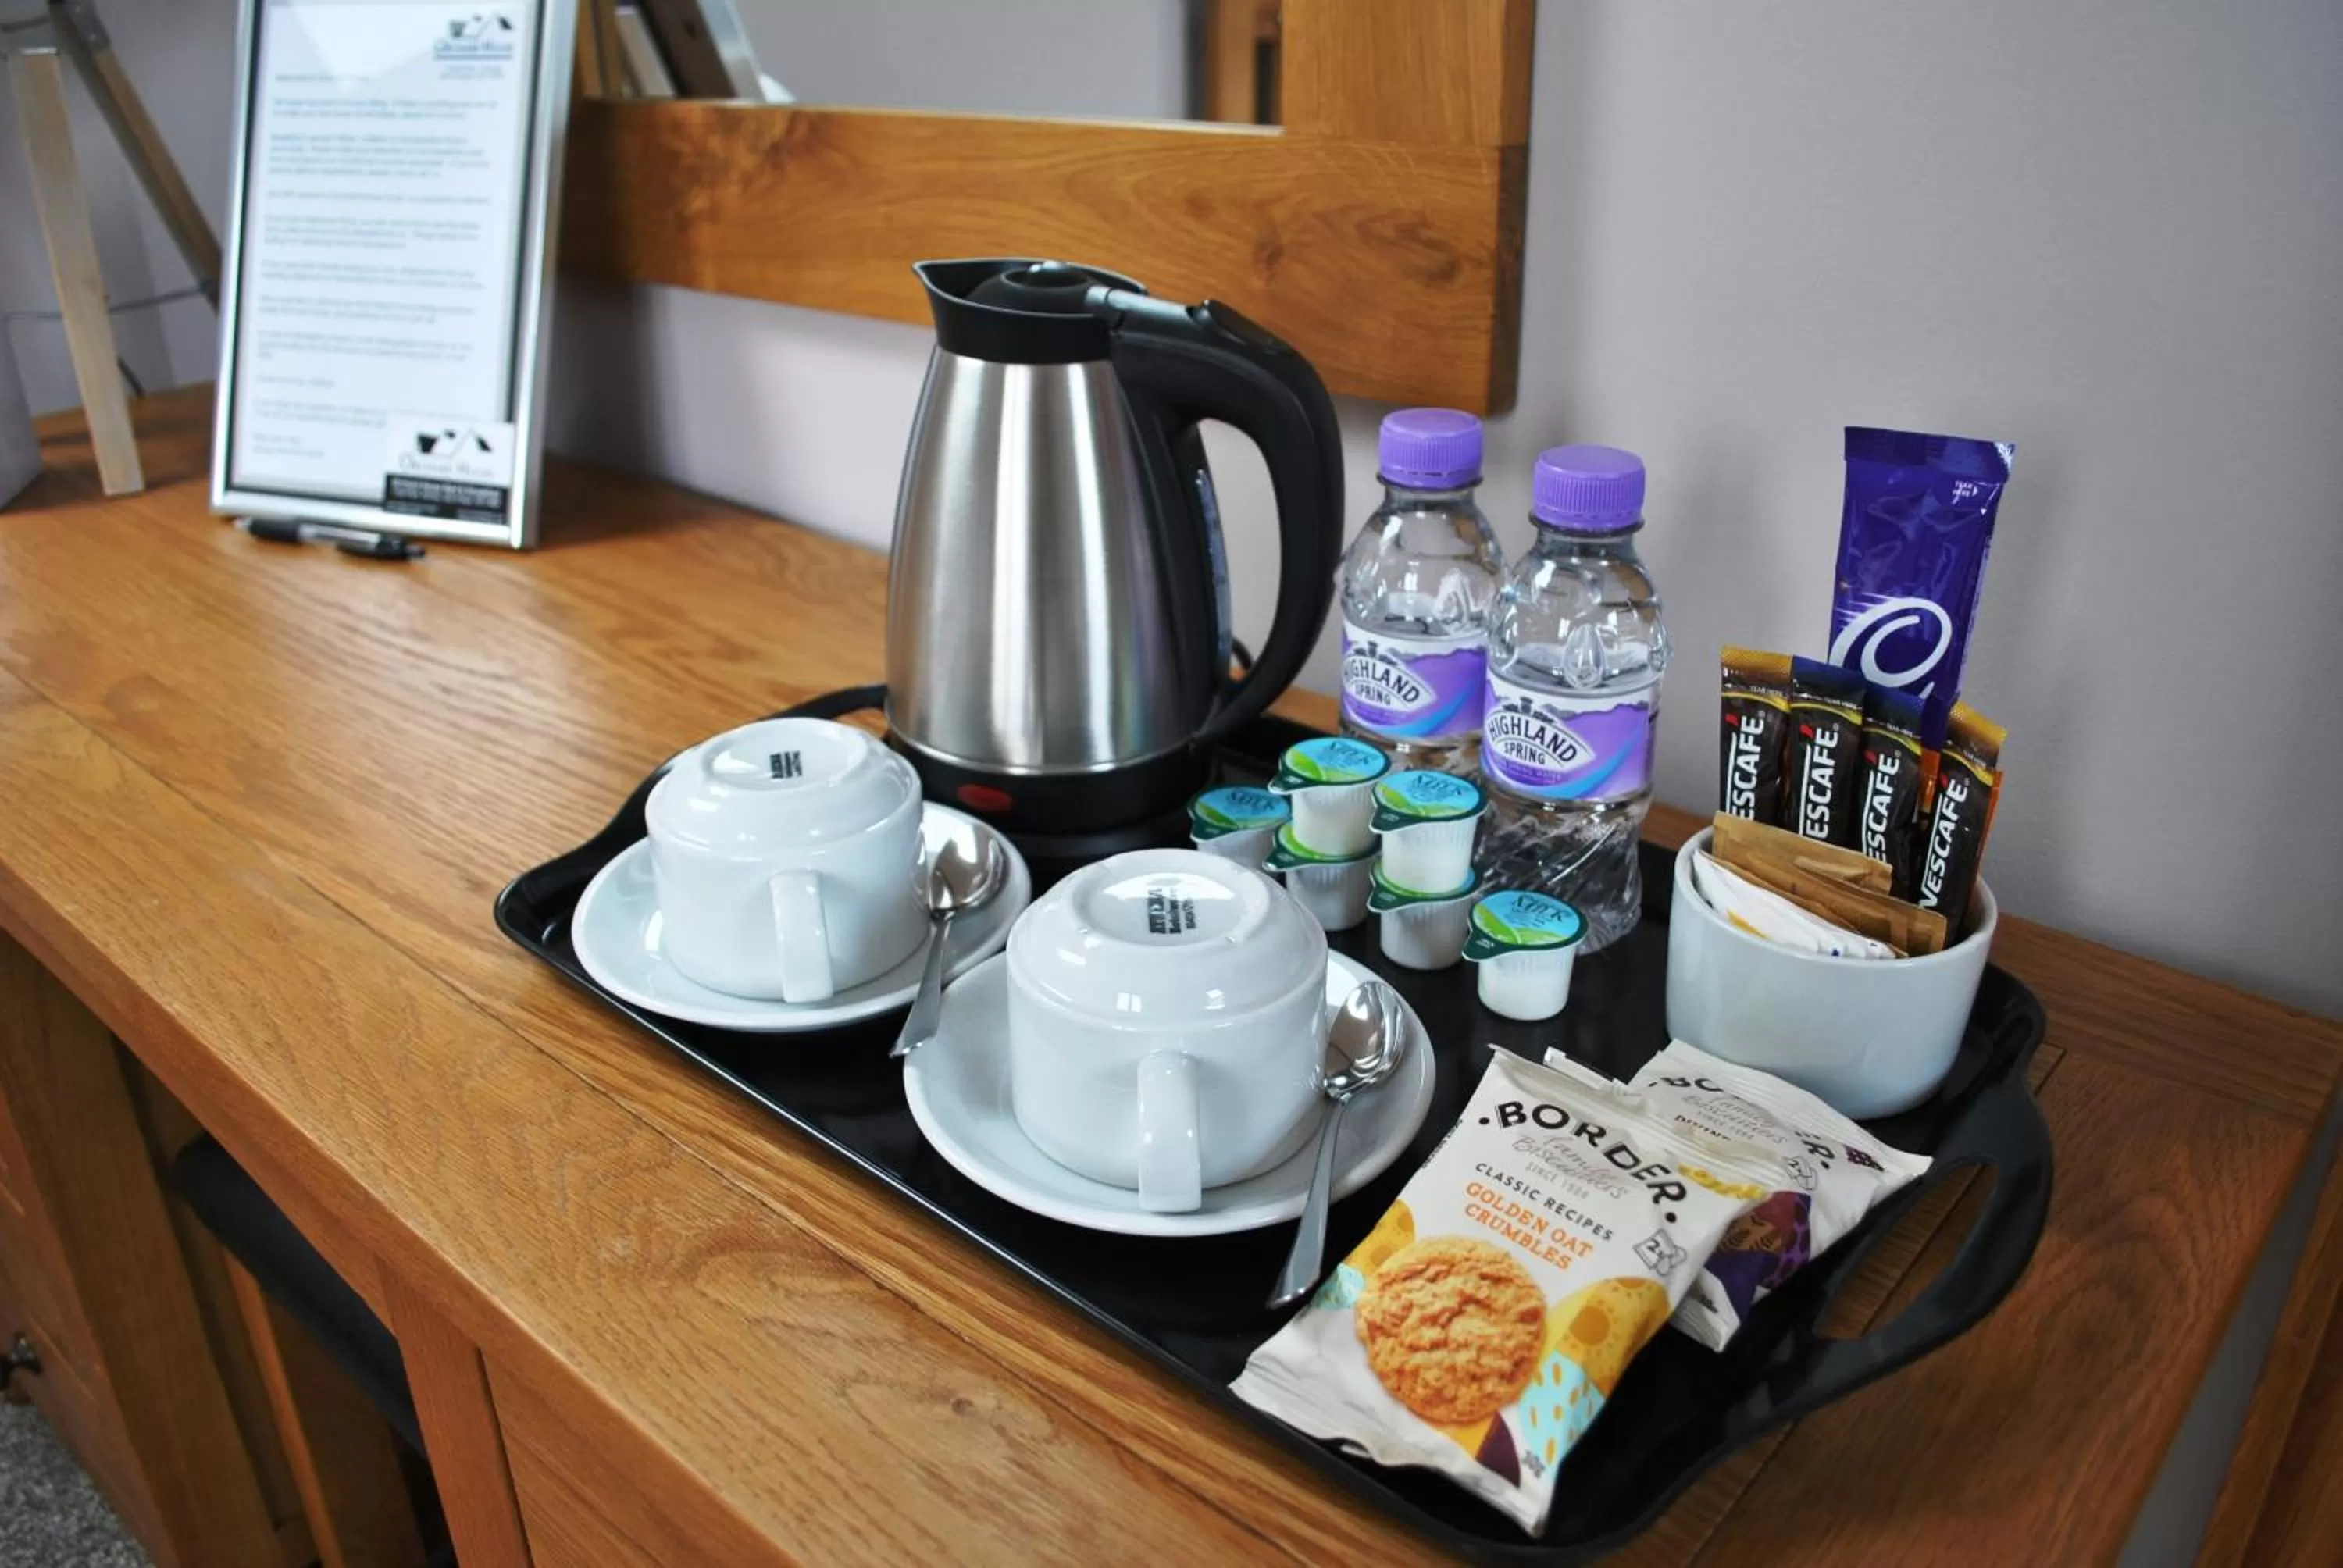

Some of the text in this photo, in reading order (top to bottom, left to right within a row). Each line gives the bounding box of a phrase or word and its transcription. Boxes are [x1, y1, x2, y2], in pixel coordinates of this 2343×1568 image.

[1489, 715, 1577, 762] HIGHLAND
[1504, 742, 1546, 765] SPRING
[1496, 1101, 1687, 1204] BORDER
[1465, 1203, 1572, 1270] CRUMBLES
[1466, 1181, 1550, 1234] GOLDEN
[1550, 1228, 1593, 1258] OAT
[1475, 1163, 1542, 1200] CLASSIC
[1543, 1197, 1614, 1241] RECIPES
